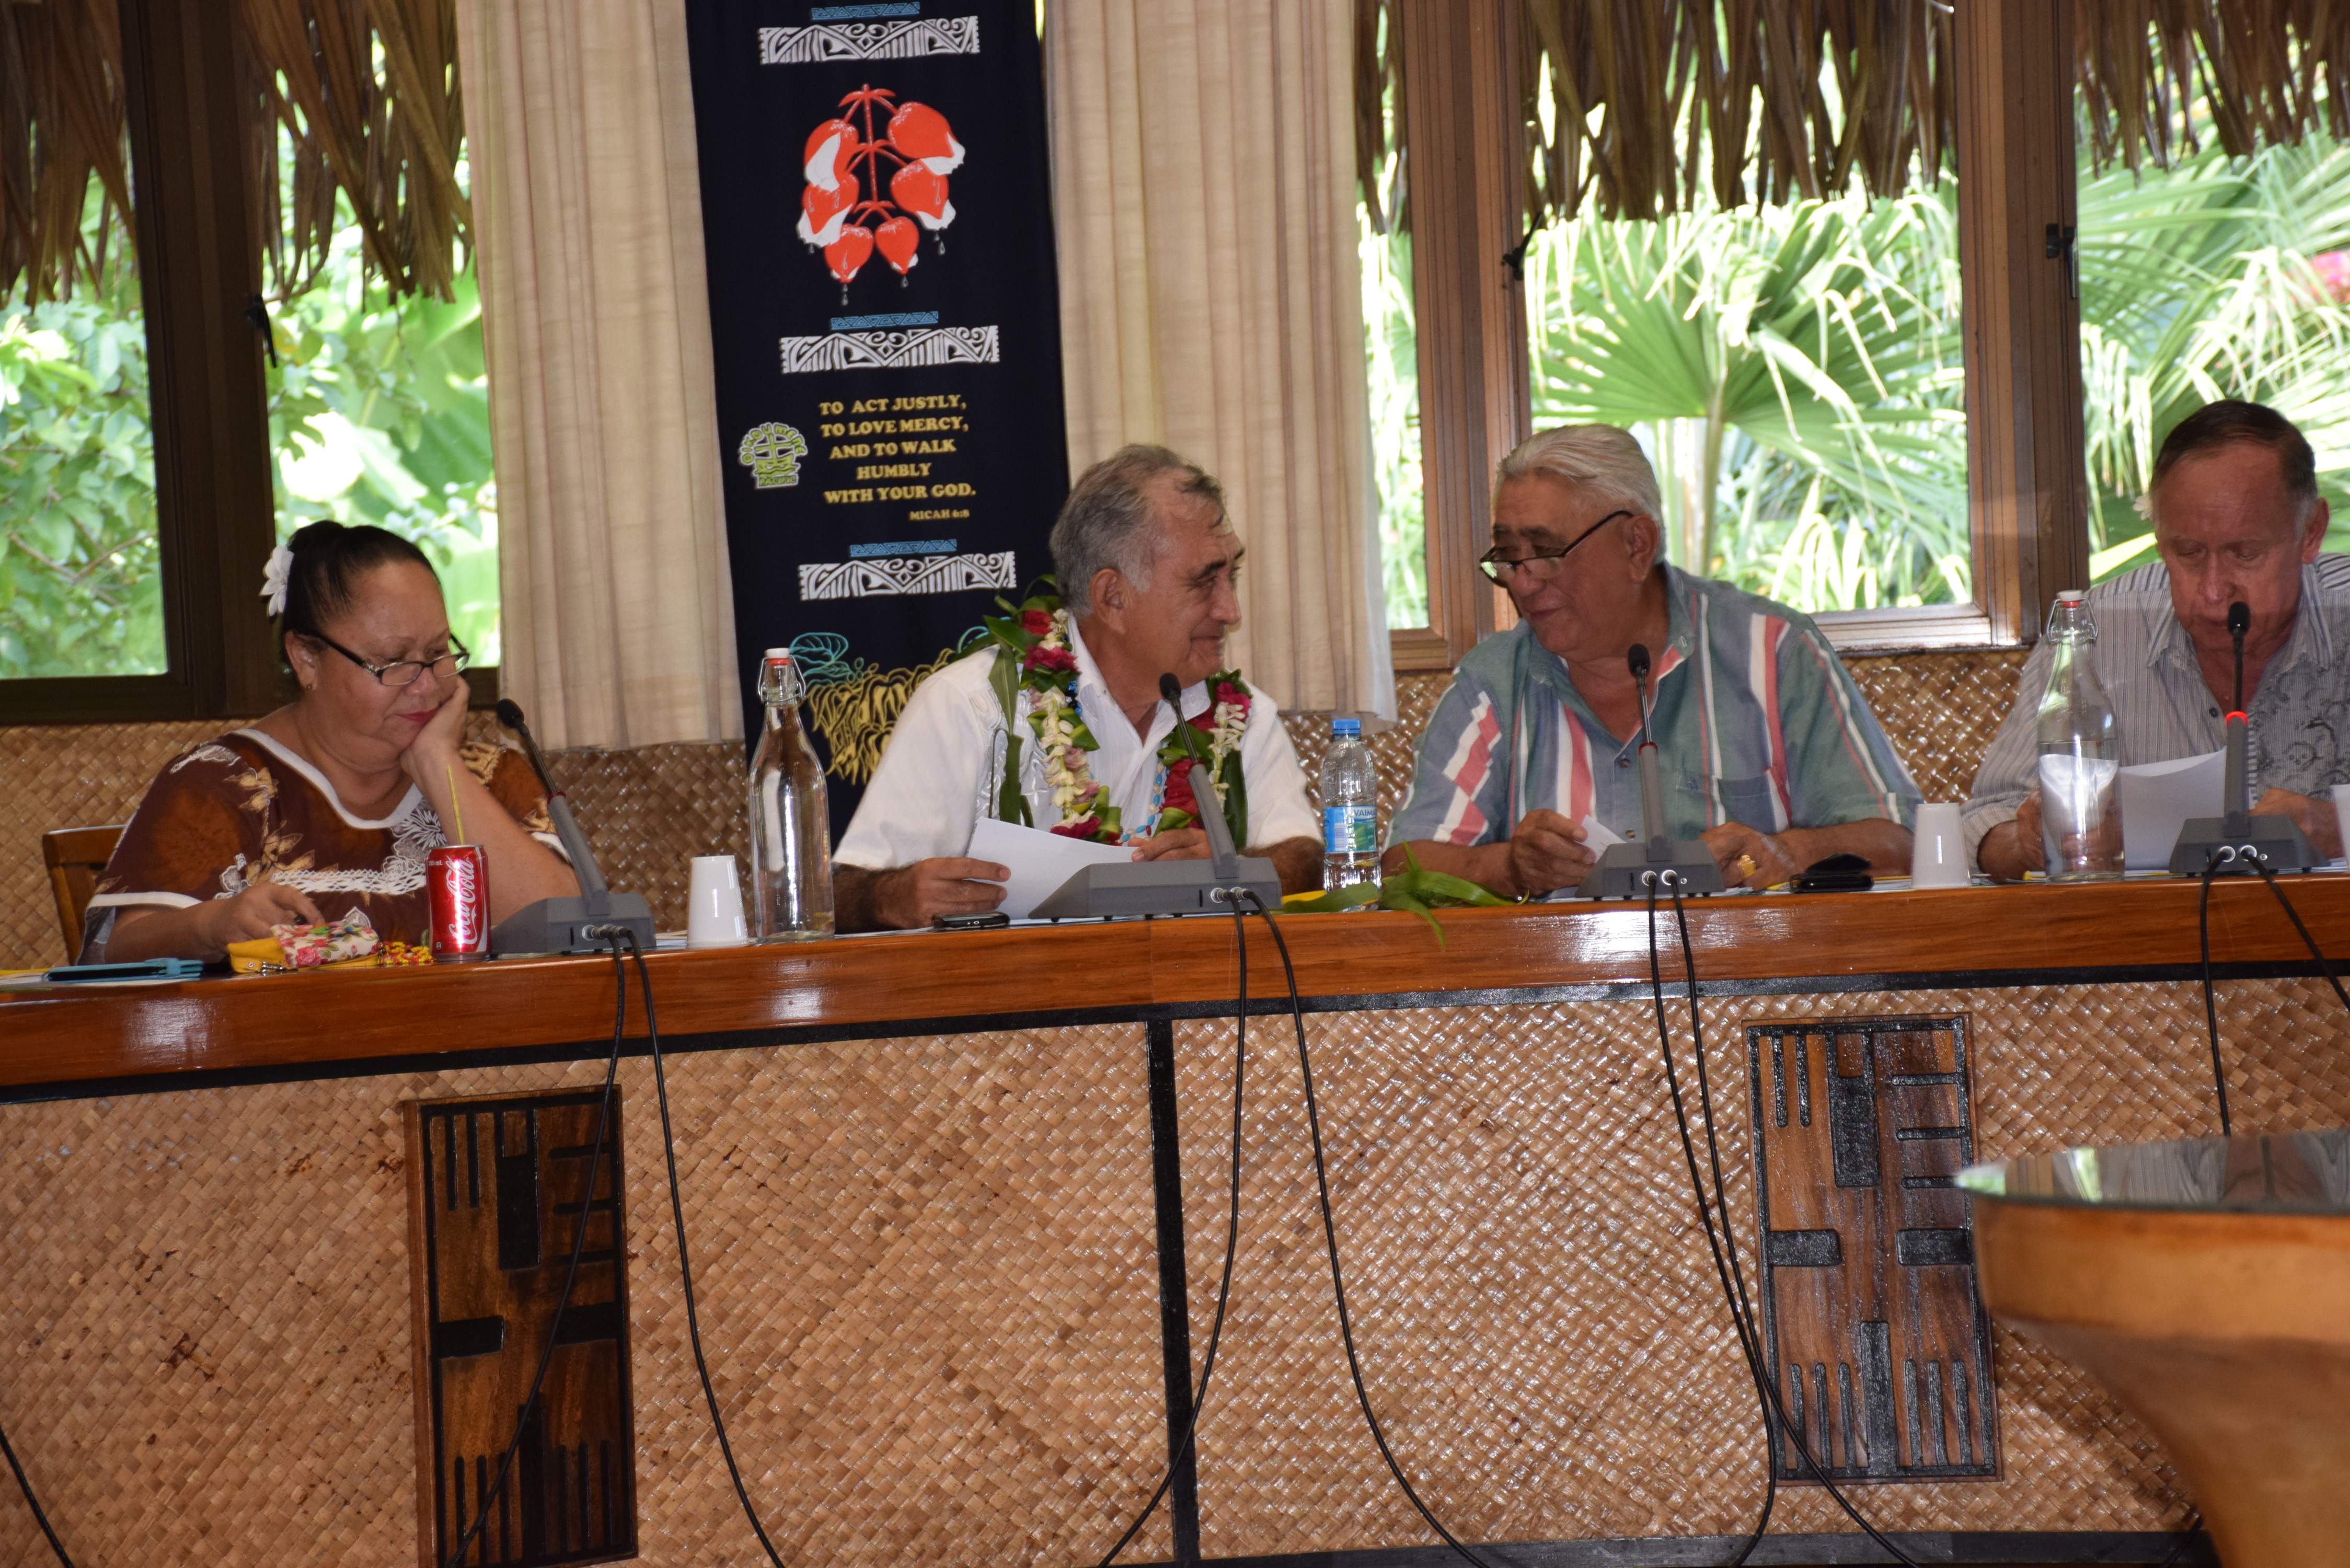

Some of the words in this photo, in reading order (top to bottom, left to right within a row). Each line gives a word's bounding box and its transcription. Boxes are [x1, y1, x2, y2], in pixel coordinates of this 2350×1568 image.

[819, 401, 844, 416] TO
[851, 399, 889, 413] ACT
[892, 395, 966, 410] JUSTLY,
[821, 422, 845, 437] TO
[848, 420, 897, 436] LOVE
[899, 417, 969, 432] MERCY,
[830, 444, 871, 459] AND
[873, 442, 898, 456] TO
[901, 439, 957, 454] WALK
[759, 475, 797, 486] PACIFIC
[856, 463, 932, 480] HUMBLY
[823, 488, 873, 504] WITH
[877, 485, 928, 500] YOUR
[930, 483, 976, 498] GOD.
[909, 509, 950, 521] MICAH
[952, 509, 970, 518] 6:8
[446, 855, 478, 944] CocaCola
